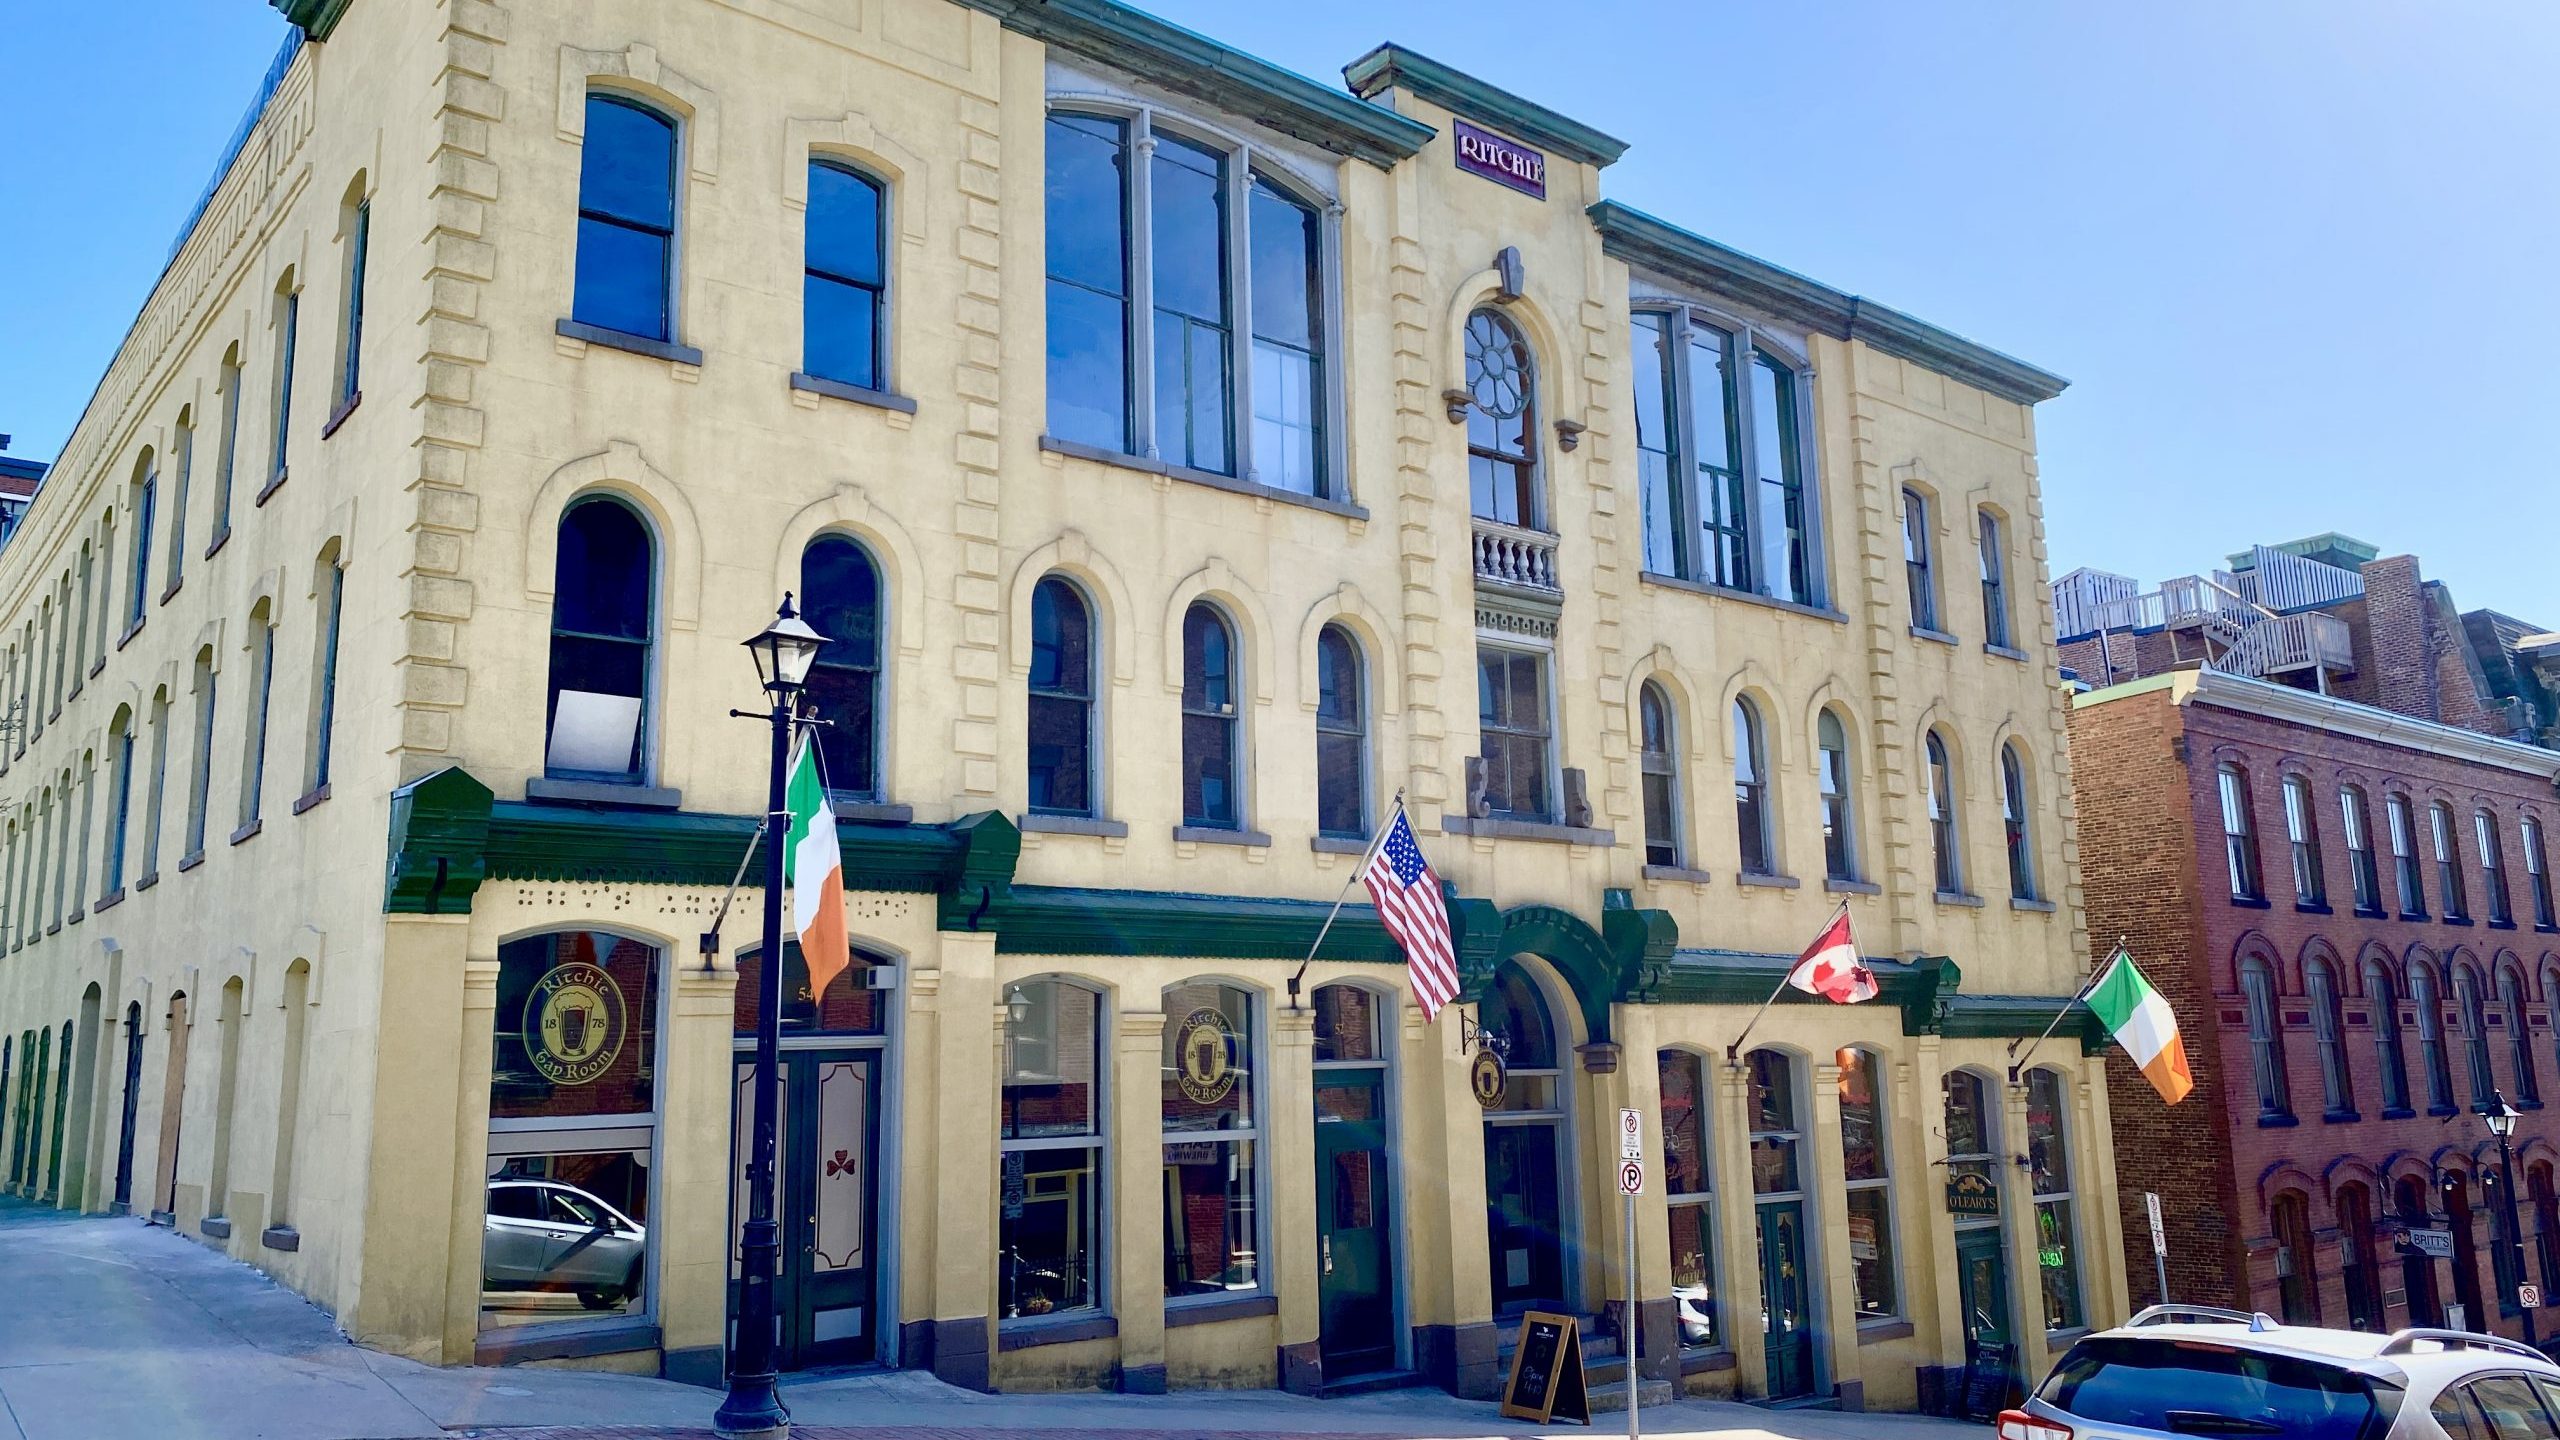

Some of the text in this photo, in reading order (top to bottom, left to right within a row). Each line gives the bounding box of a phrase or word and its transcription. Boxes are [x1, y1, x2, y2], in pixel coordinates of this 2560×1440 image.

[1460, 135, 1543, 185] RITCHIE
[541, 970, 609, 996] Ritchie
[545, 1019, 557, 1030] 18
[592, 1018, 606, 1029] 78
[1186, 1012, 1227, 1032] Ritchie
[566, 1050, 611, 1079] Room
[1202, 1077, 1232, 1100] Room
